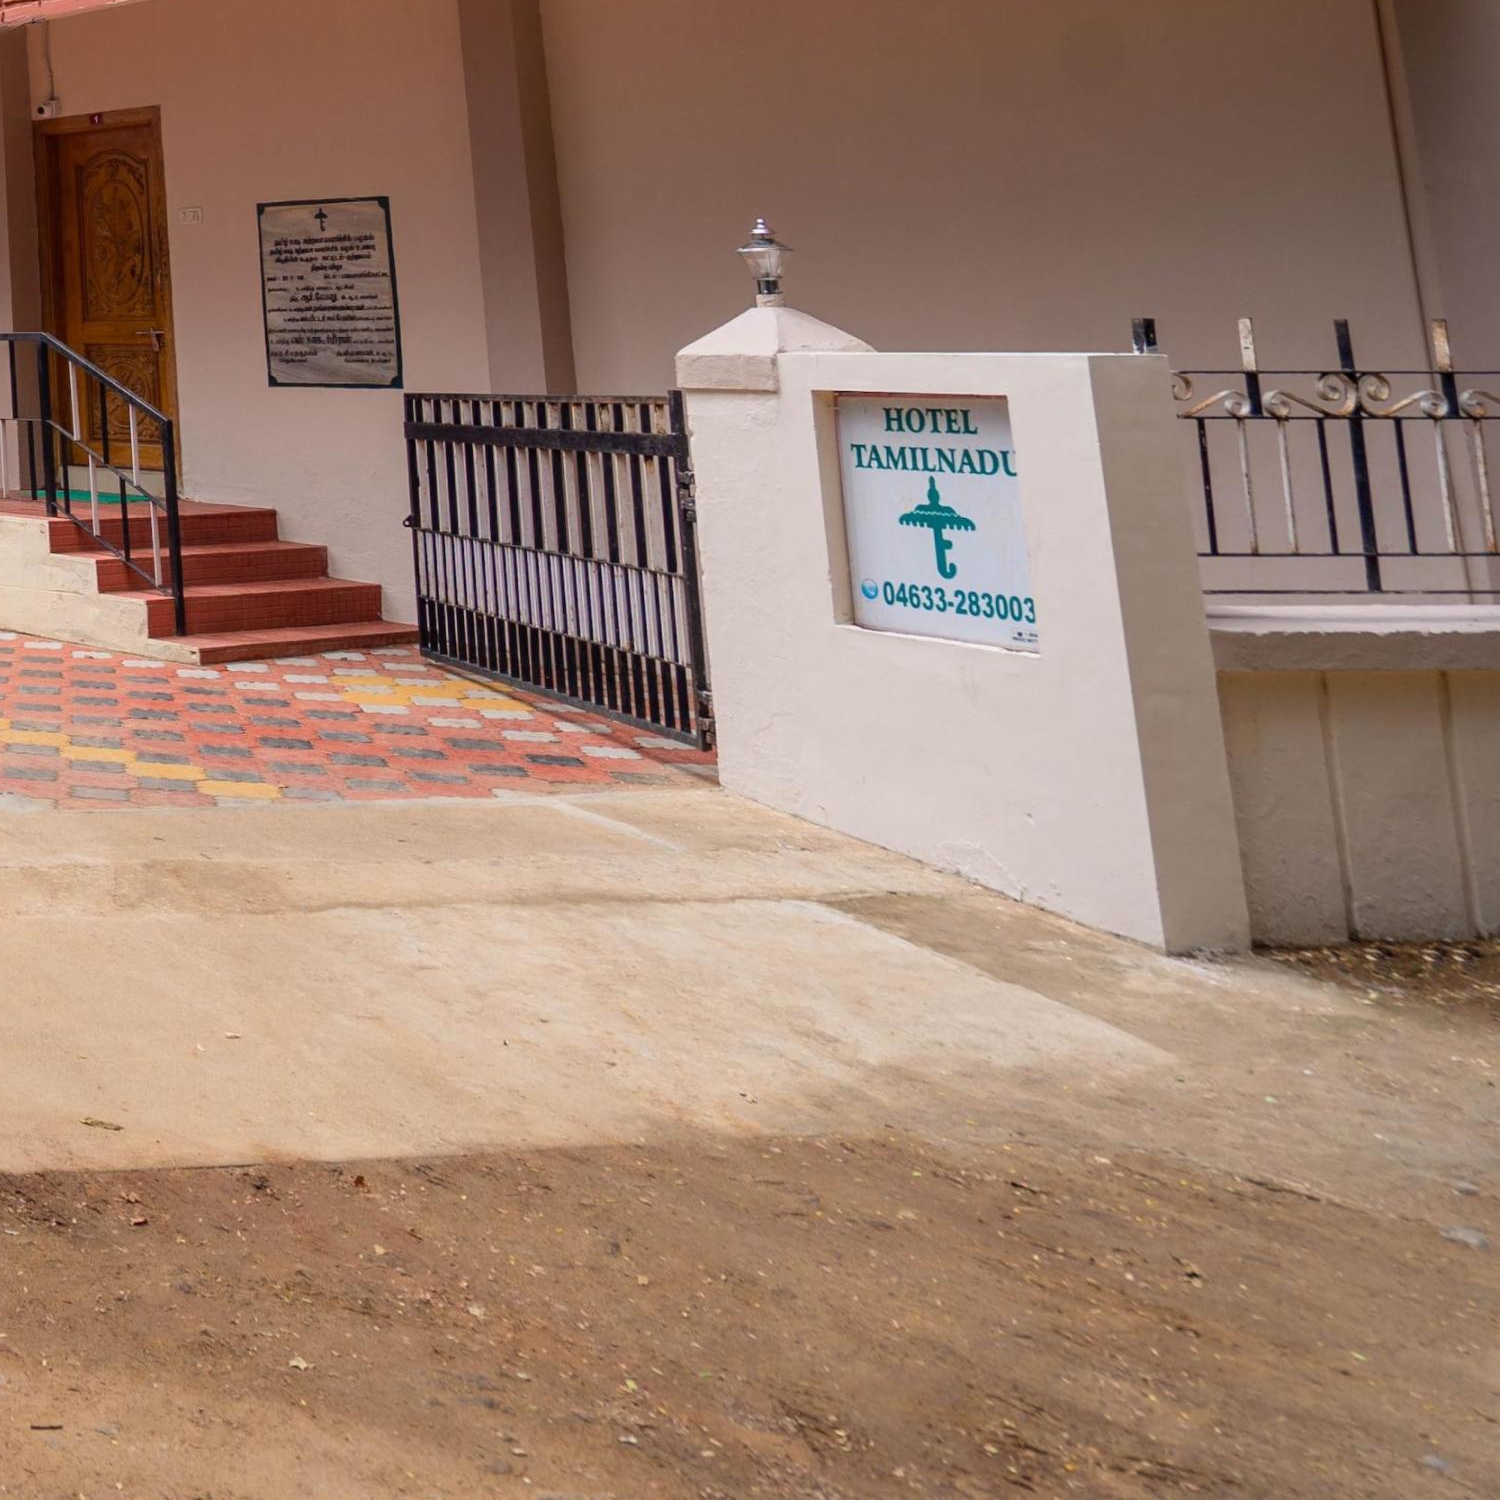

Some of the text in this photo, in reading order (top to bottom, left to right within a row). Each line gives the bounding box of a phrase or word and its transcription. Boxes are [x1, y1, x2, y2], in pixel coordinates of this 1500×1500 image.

[883, 407, 978, 435] HOTEL
[851, 444, 1017, 477] TAMILNADU
[883, 581, 1036, 624] 04633-283003
